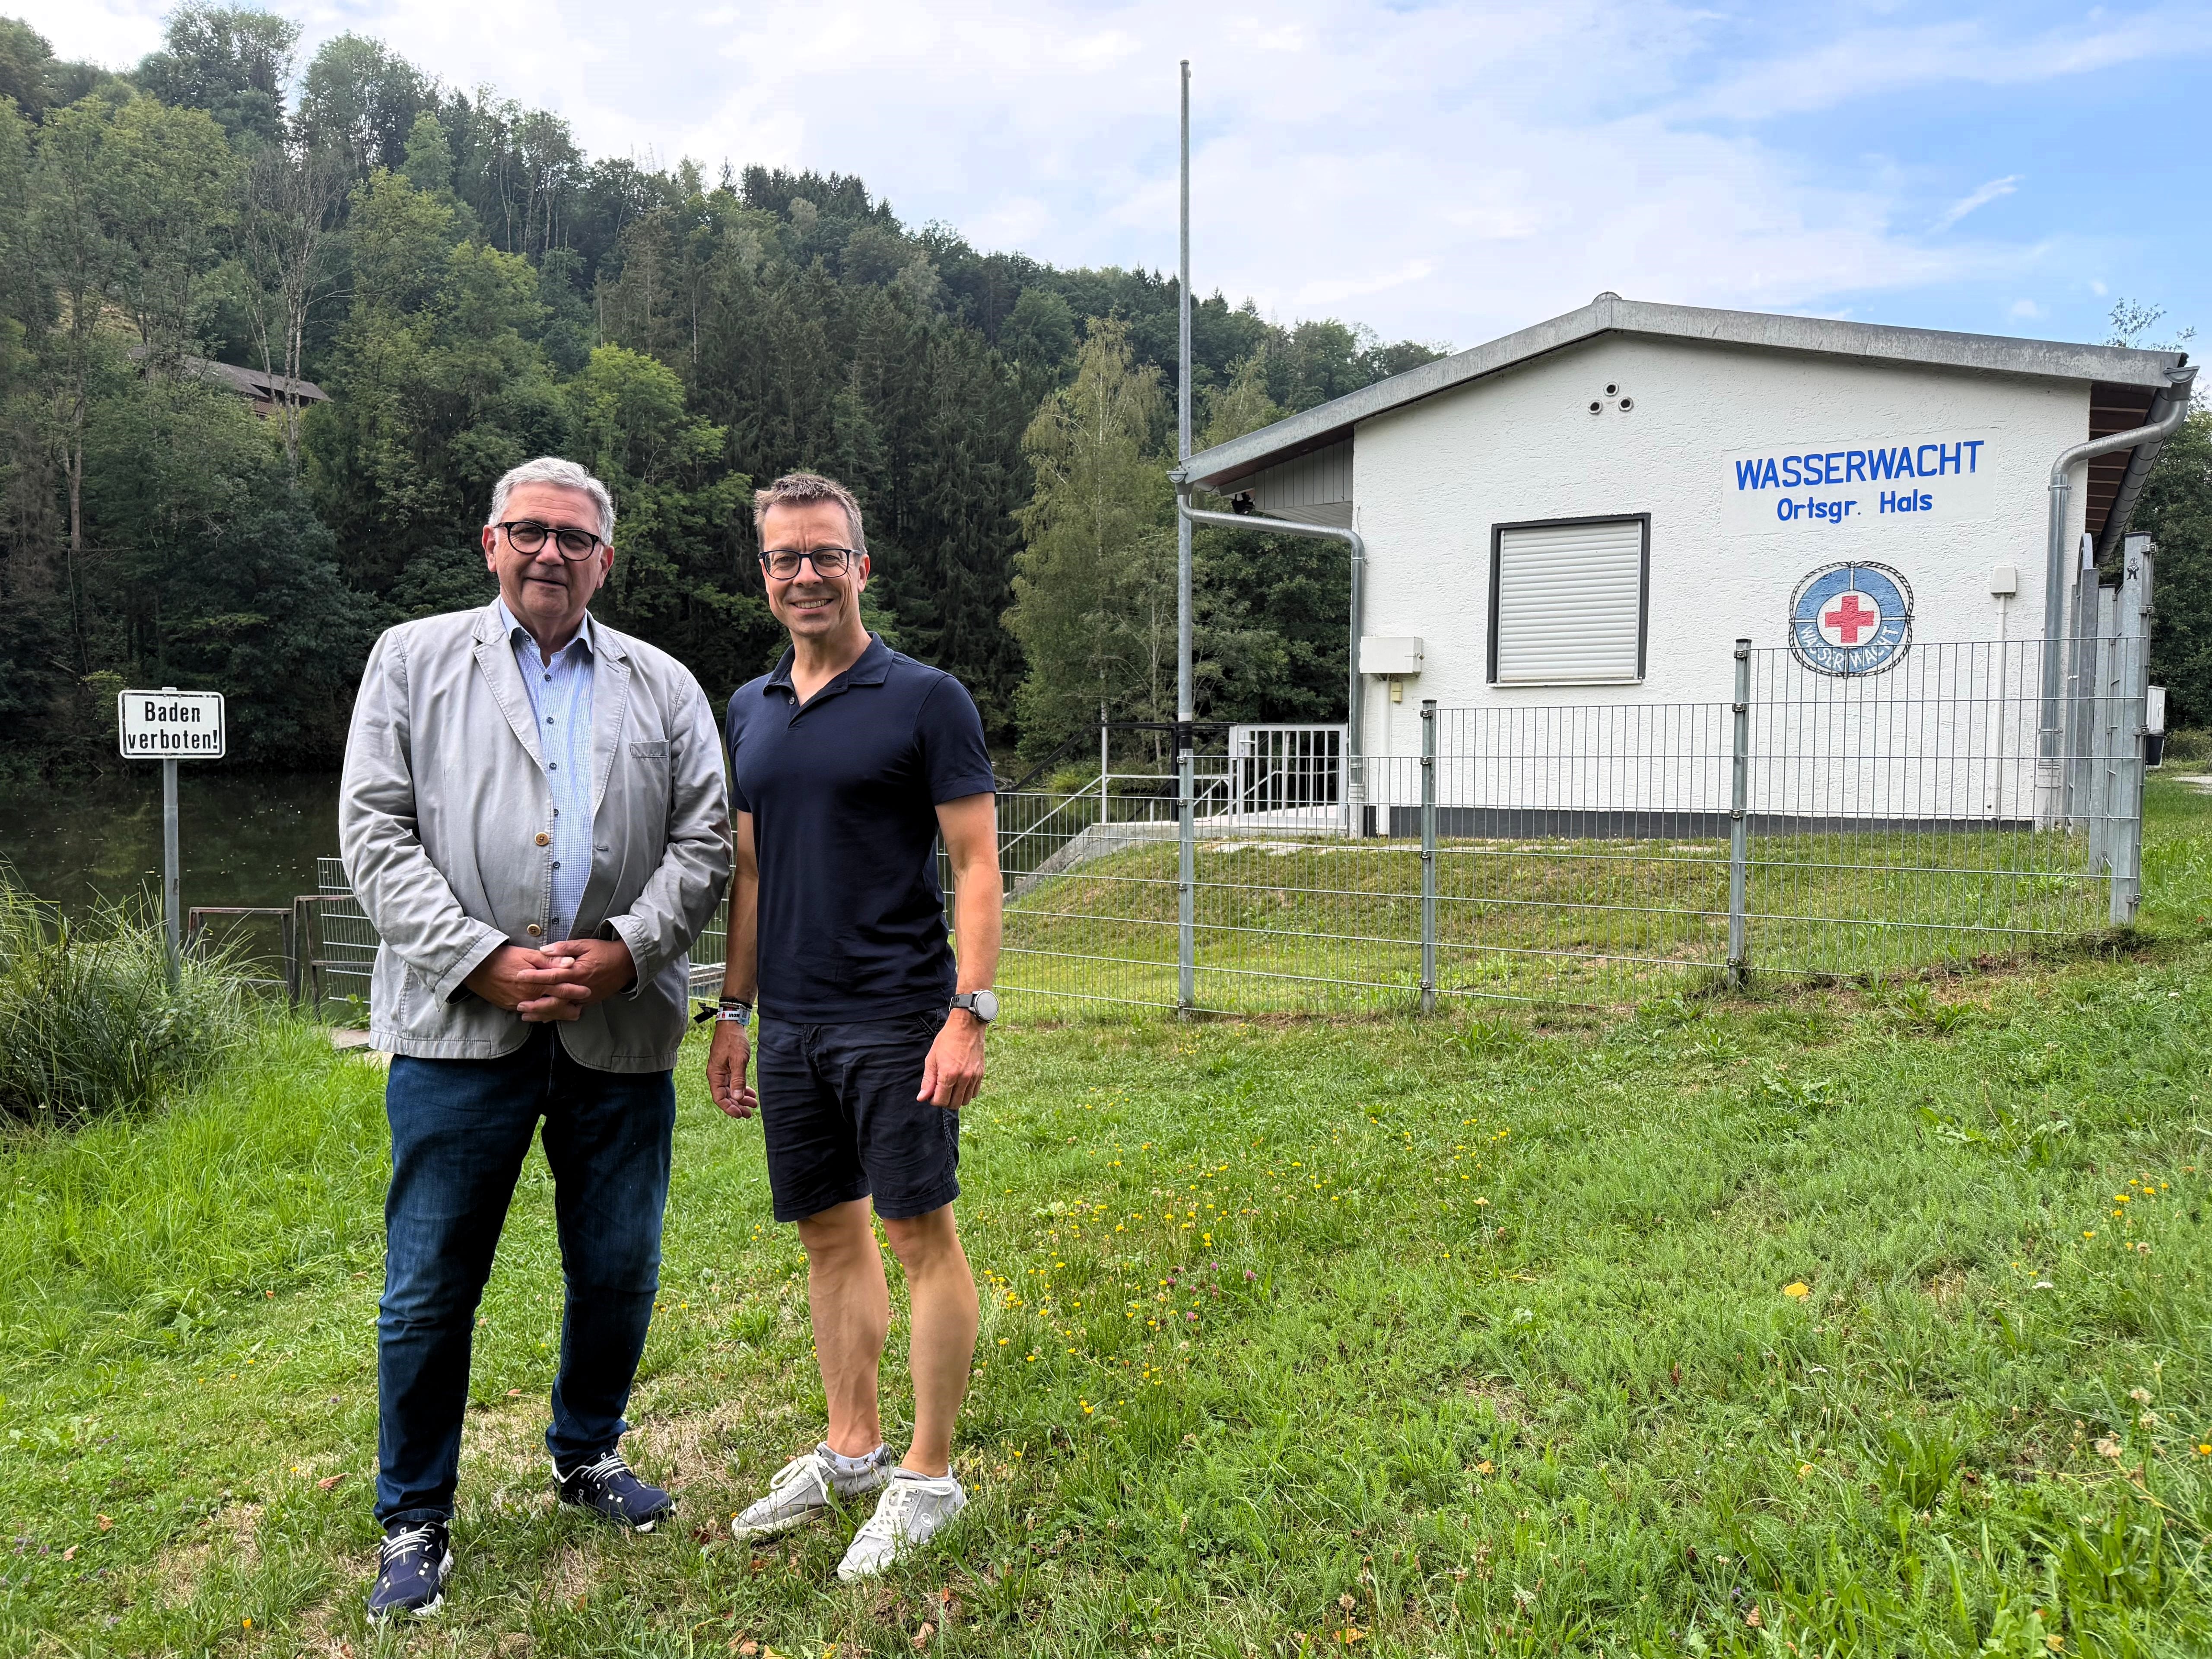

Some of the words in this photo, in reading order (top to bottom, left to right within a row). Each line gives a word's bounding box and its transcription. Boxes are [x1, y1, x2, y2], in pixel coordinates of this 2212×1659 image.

[1735, 440, 1984, 490] WASSERWACHT
[1777, 496, 1861, 524] Ortsgr.
[1880, 489, 1933, 514] Hals
[144, 701, 200, 722] Baden
[127, 729, 218, 749] verboten!
